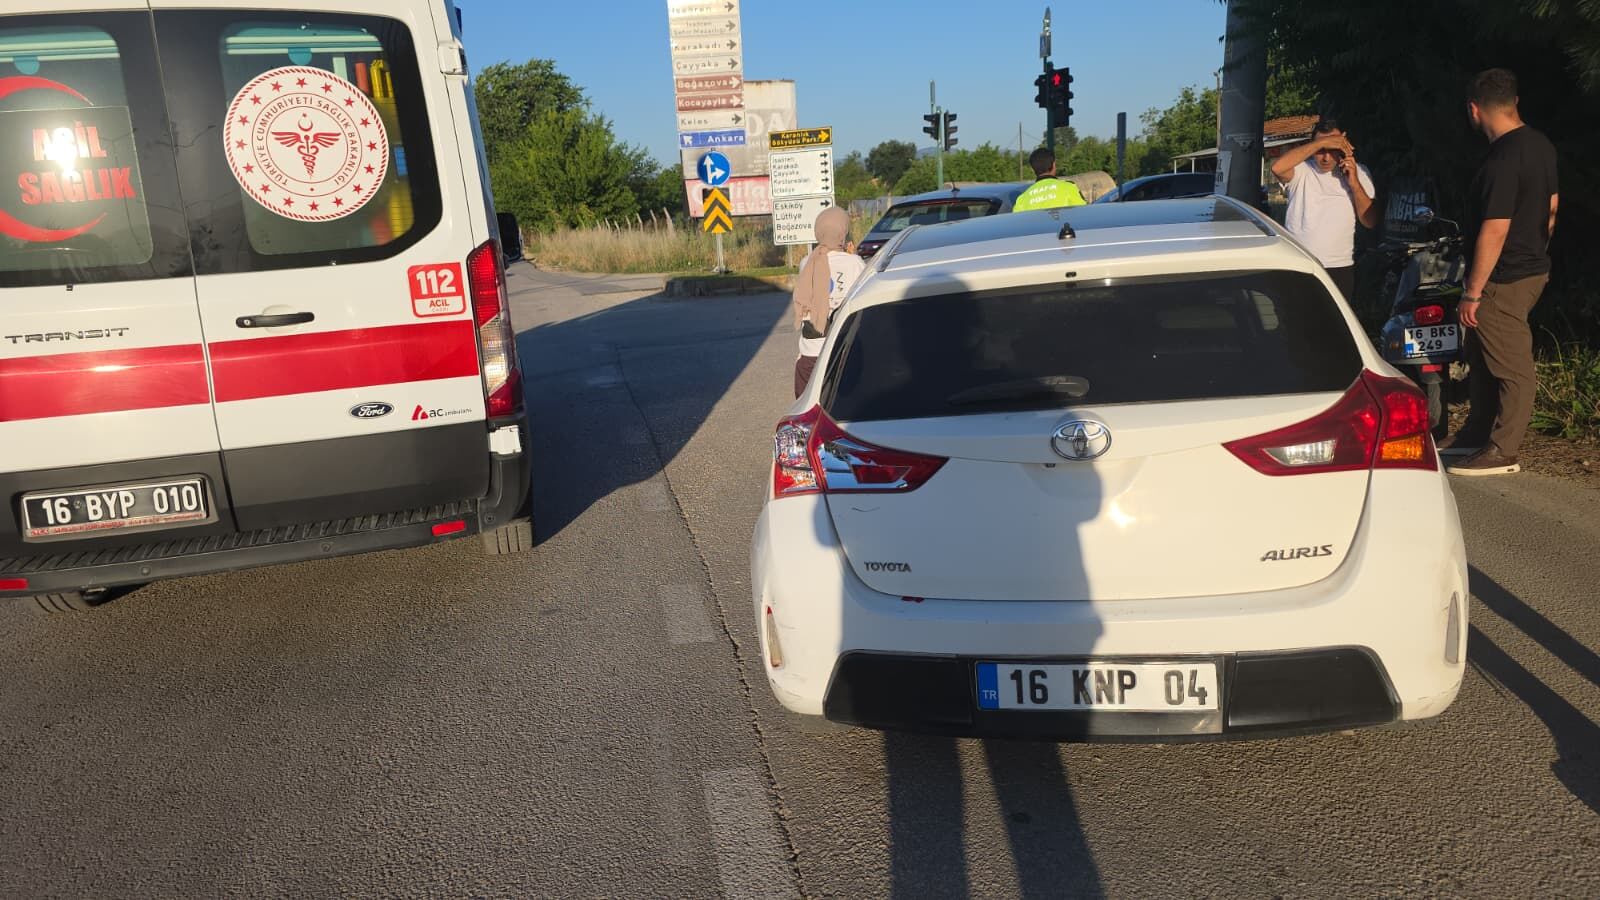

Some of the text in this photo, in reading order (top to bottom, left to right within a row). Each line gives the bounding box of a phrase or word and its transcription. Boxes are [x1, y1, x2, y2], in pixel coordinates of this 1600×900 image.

[677, 79, 728, 90] Boğazova
[678, 97, 727, 108] Kocayayla
[681, 118, 709, 126] Keles
[257, 96, 313, 141] CUMHURİYETİ
[317, 100, 351, 130] SAĞLIK
[334, 132, 358, 186] BAKANLIĞI
[707, 135, 744, 143] Ankara
[774, 202, 803, 210] Eskiköy
[775, 212, 802, 220] Lütfiye
[776, 223, 812, 231] Boğazova
[777, 233, 798, 241] Keles
[416, 268, 456, 295] 112
[5, 327, 130, 344] TRANSIT
[1408, 325, 1456, 340] 16 BKS
[1418, 339, 1443, 352] 249
[42, 497, 72, 525] 16
[84, 490, 136, 521] BYP
[152, 485, 198, 514] 010
[1260, 543, 1334, 563] AURIS
[864, 561, 912, 573] TOYOTA
[983, 669, 1208, 706] TR 16 KNP 04
